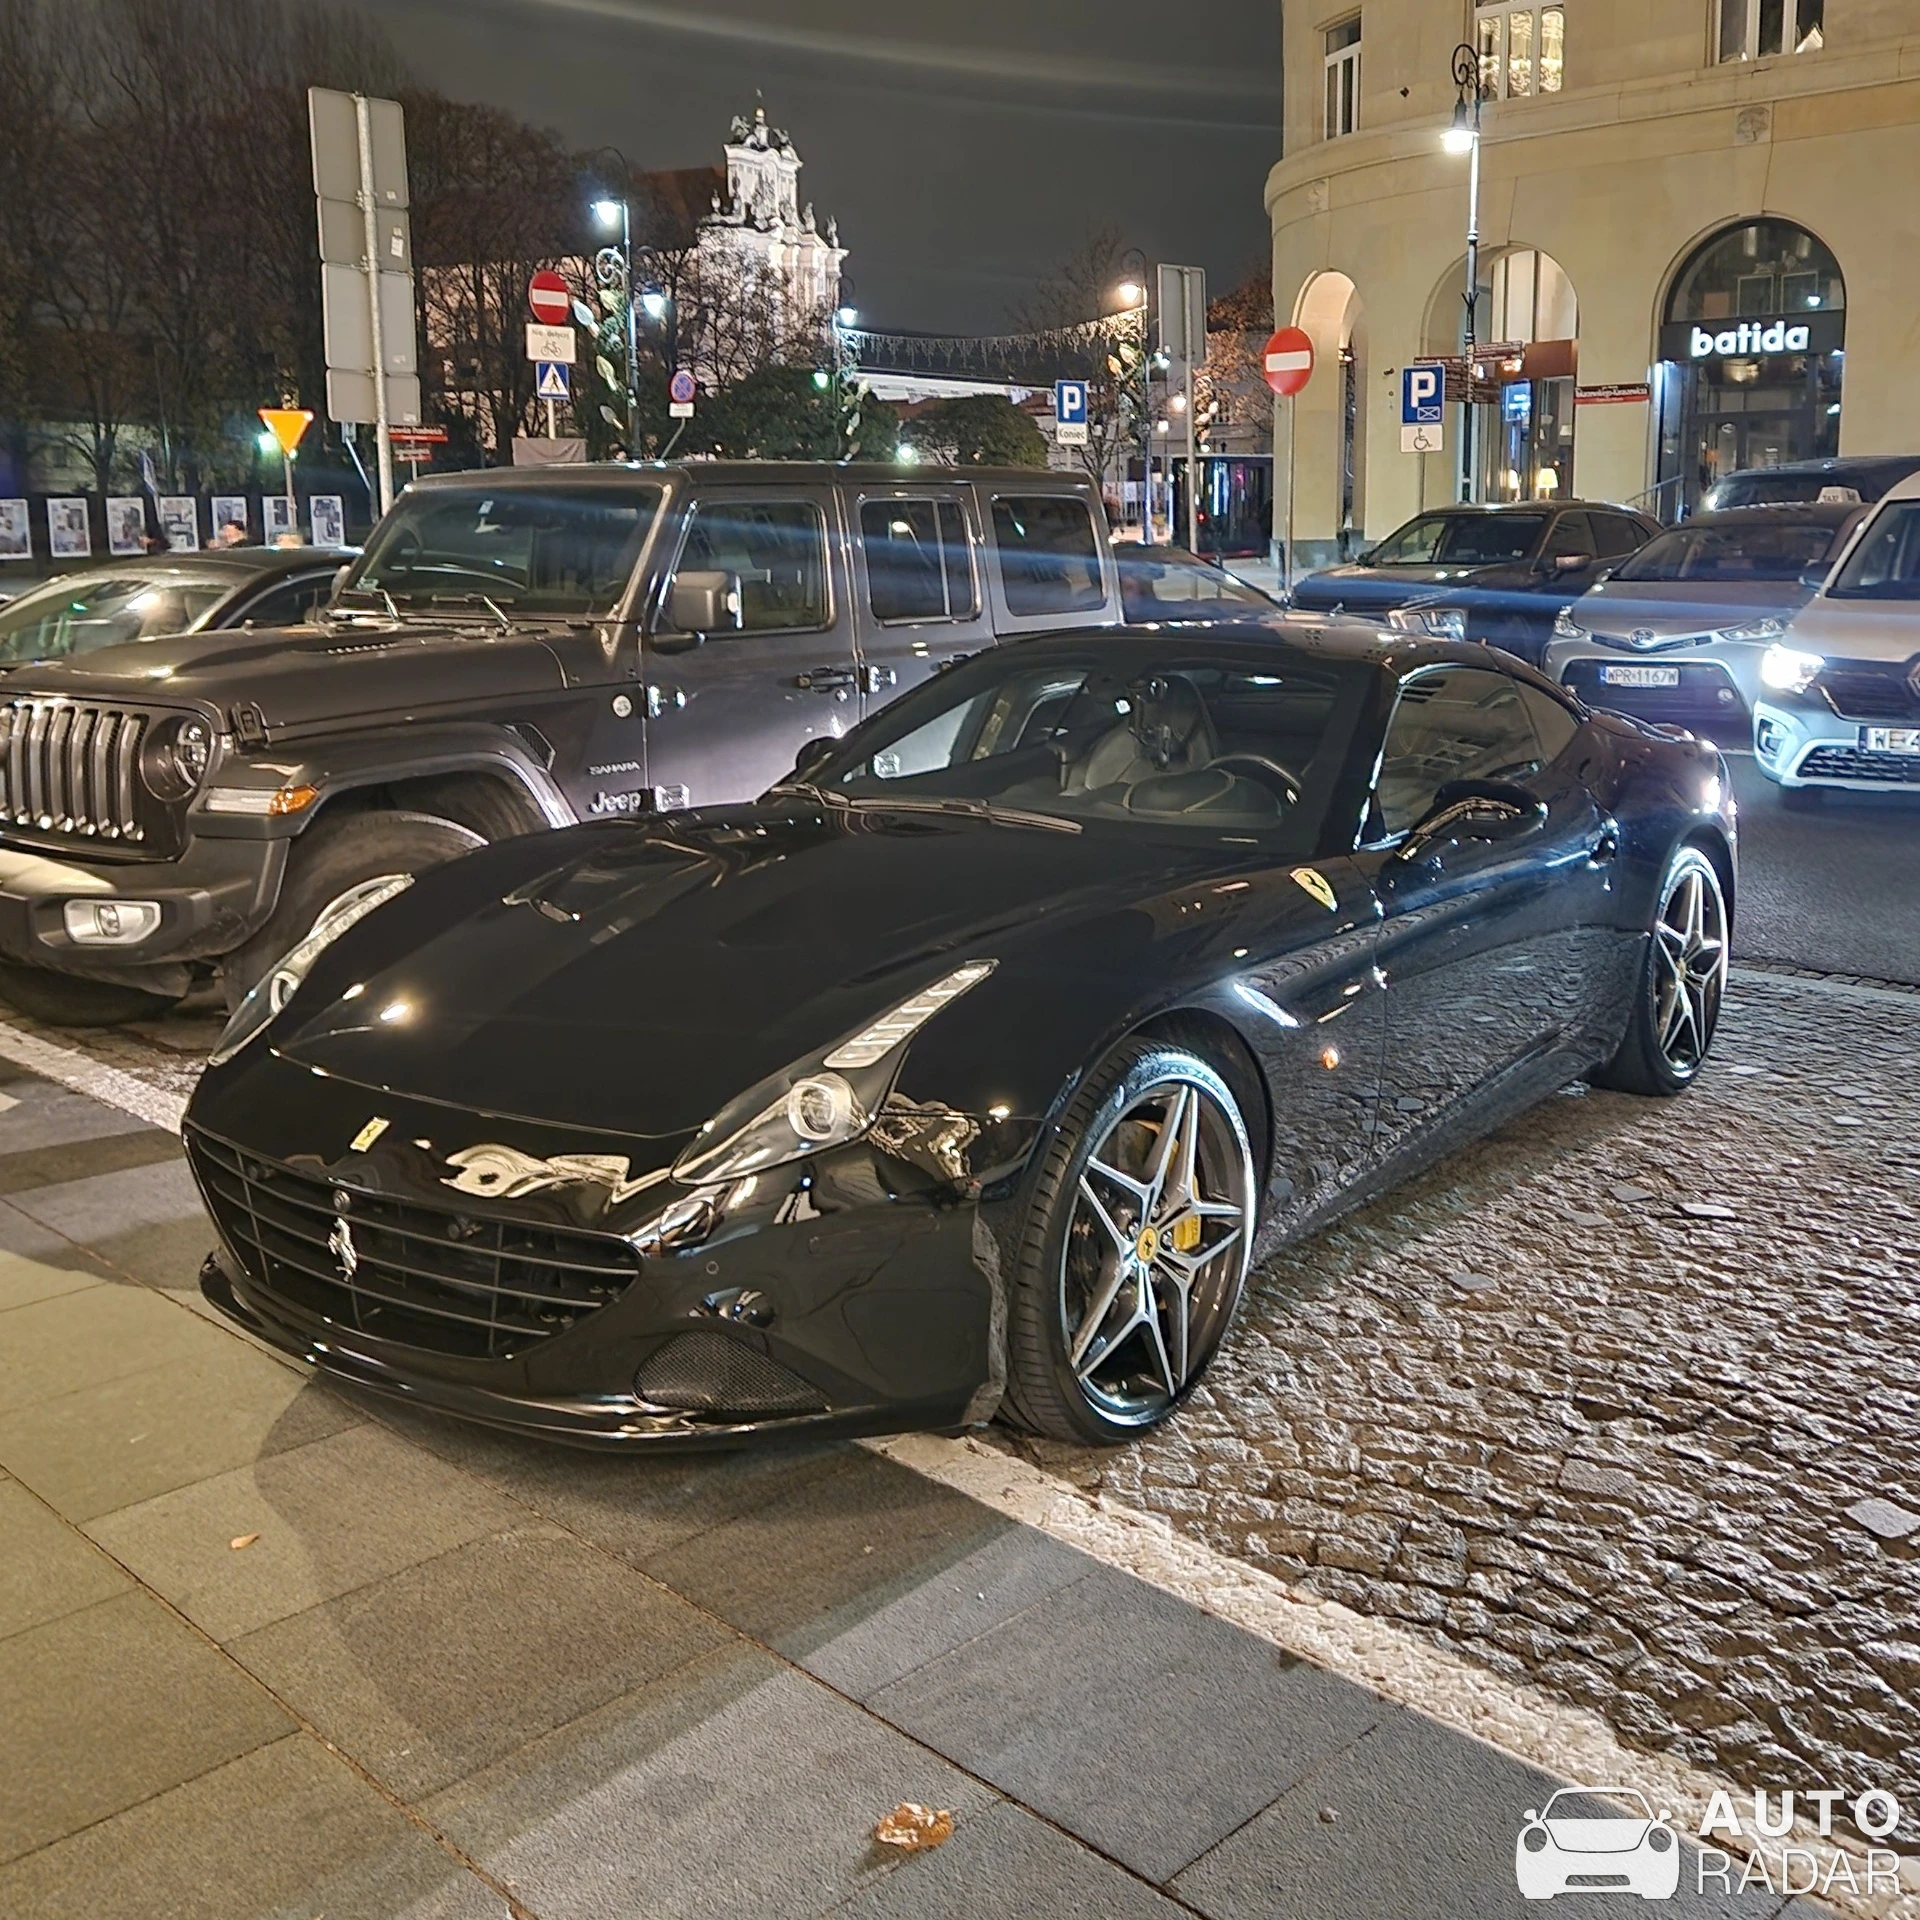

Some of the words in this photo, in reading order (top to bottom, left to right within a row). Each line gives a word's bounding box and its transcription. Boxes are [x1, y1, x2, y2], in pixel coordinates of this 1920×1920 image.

[1691, 320, 1810, 358] batida
[1063, 386, 1081, 419] P
[1411, 370, 1436, 408] P
[1059, 429, 1085, 439] Koniec
[589, 761, 640, 776] SAHARA
[590, 791, 642, 814] Jeep
